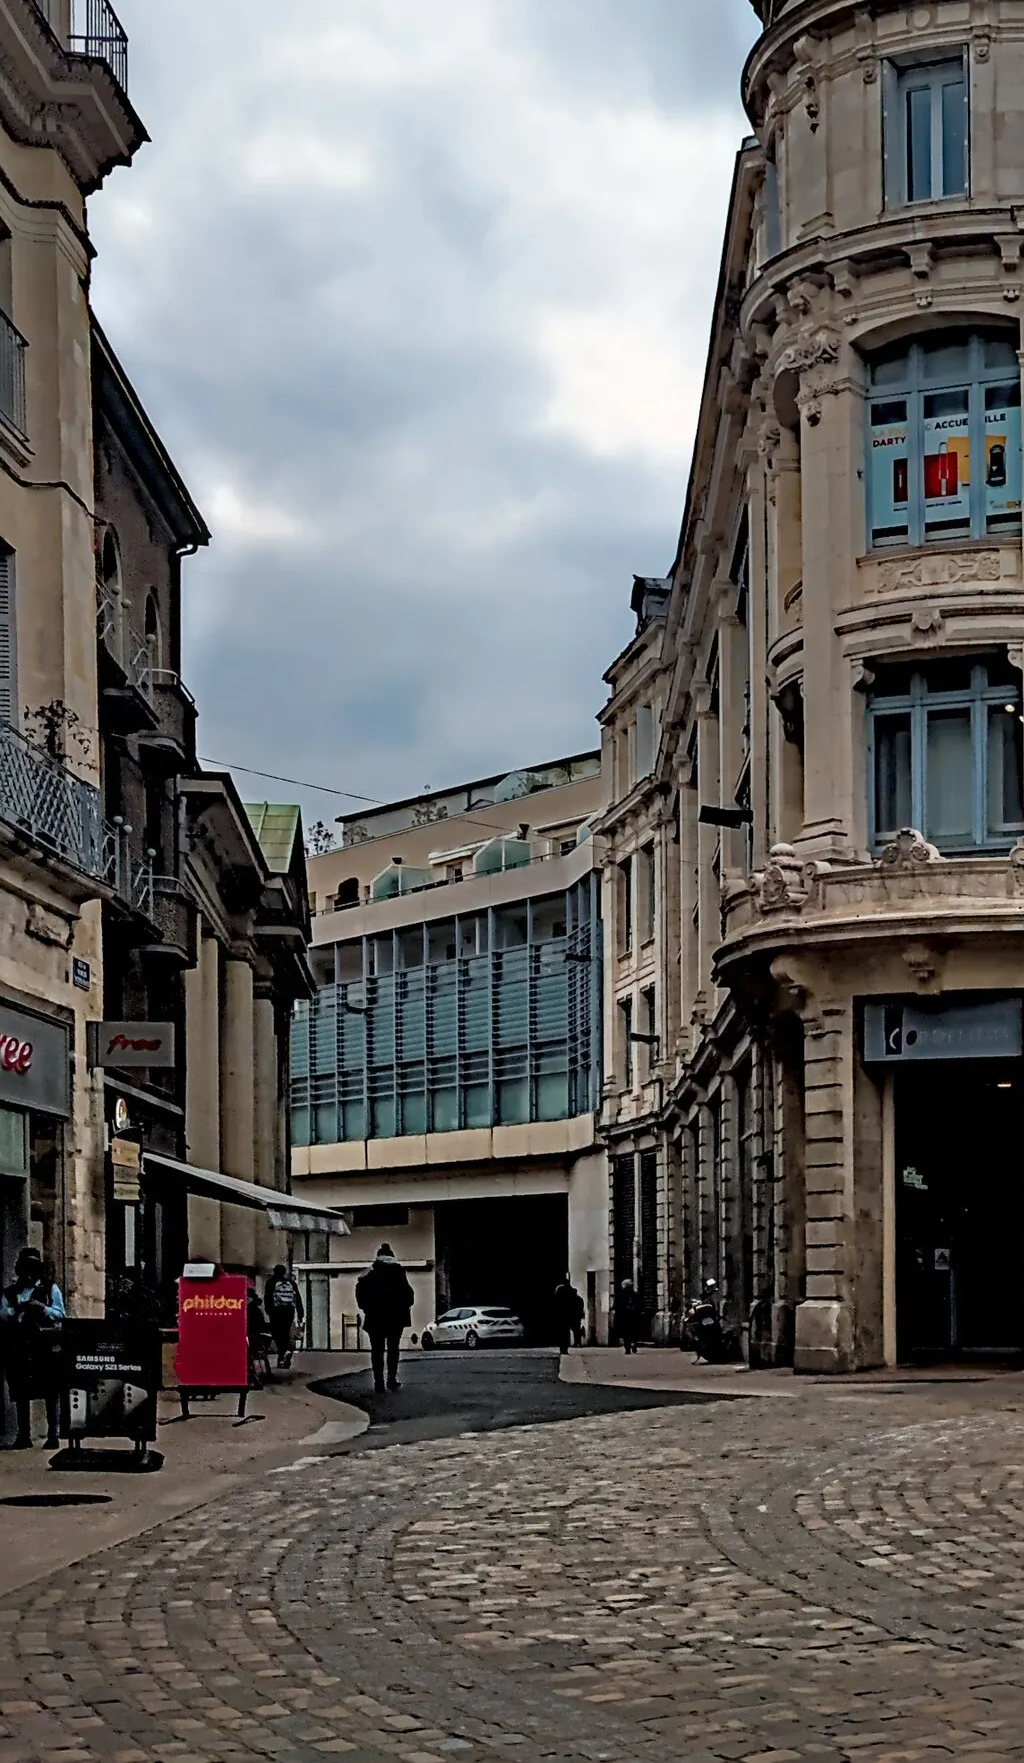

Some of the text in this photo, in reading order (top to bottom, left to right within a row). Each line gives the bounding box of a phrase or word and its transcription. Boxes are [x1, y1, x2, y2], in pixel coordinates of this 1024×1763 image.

[873, 437, 906, 448] DARTY
[183, 1294, 245, 1312] phildar
[75, 1363, 142, 1371] Galaxy S23 Series
